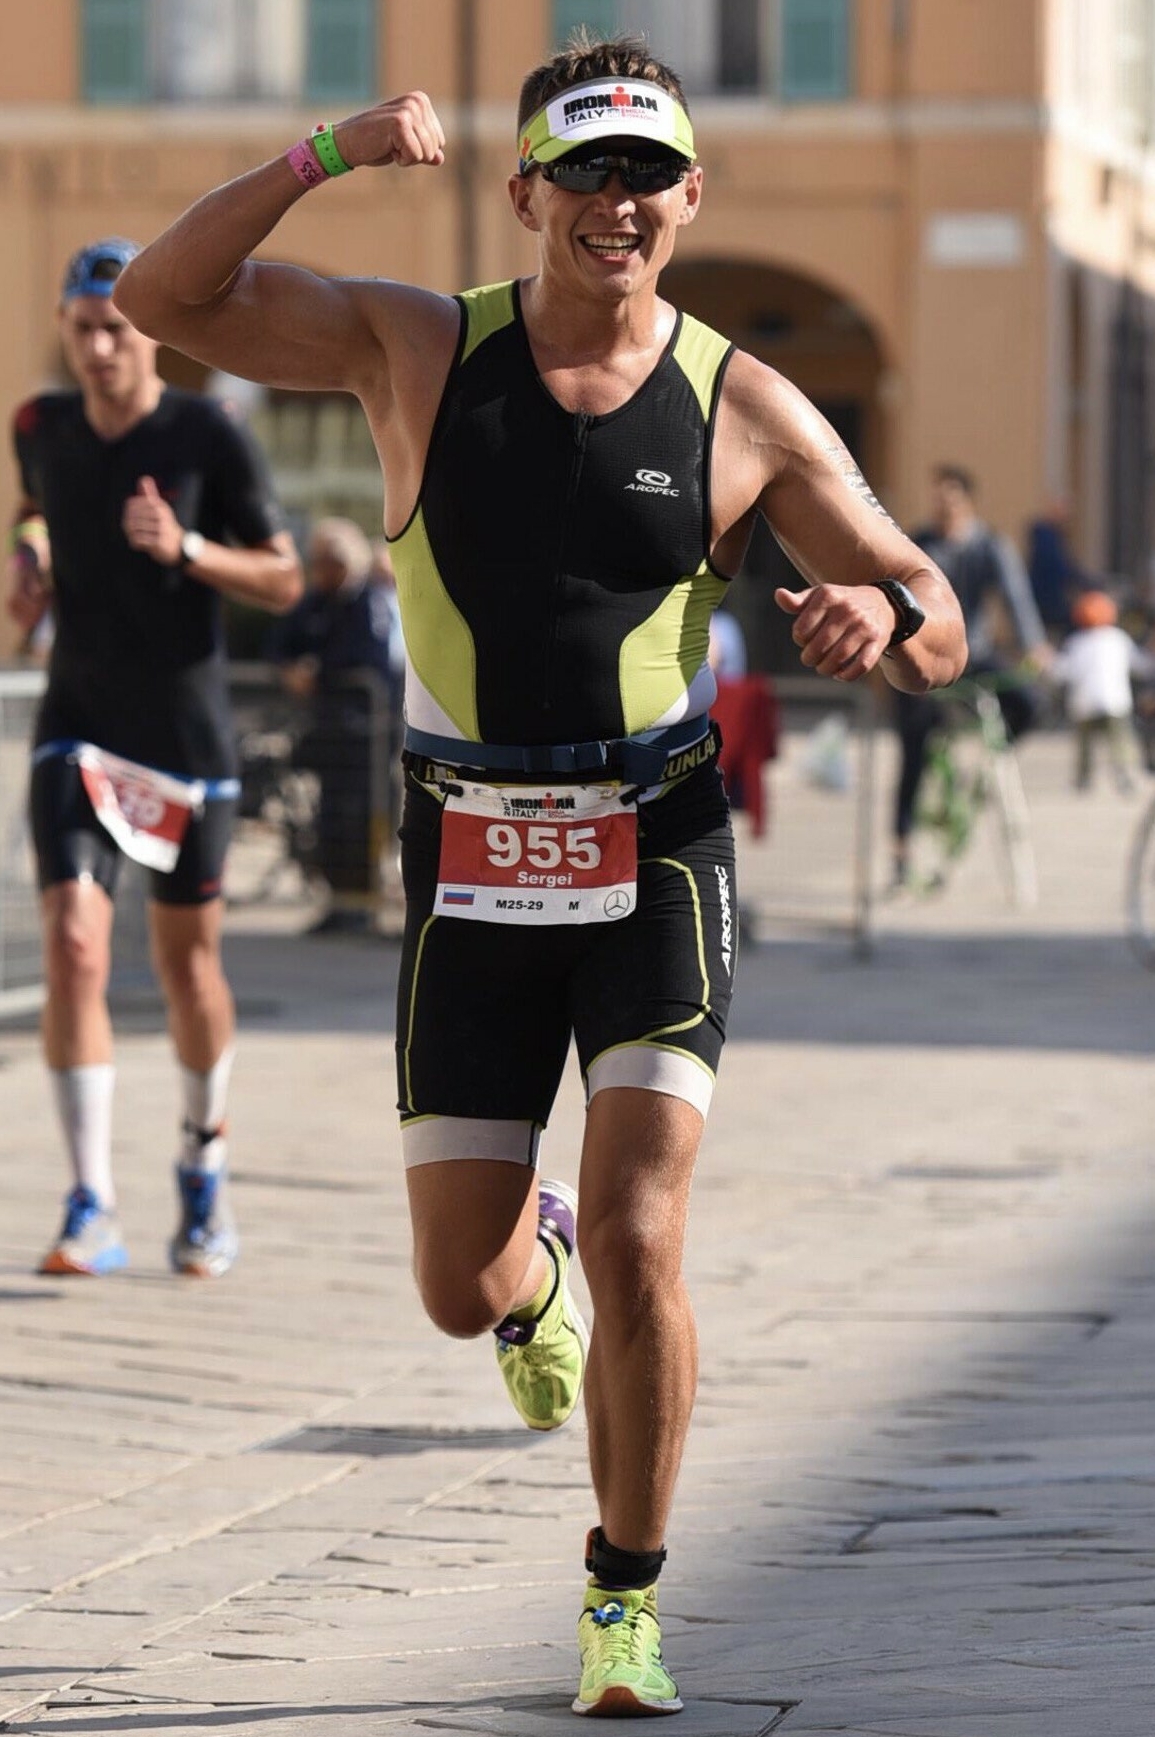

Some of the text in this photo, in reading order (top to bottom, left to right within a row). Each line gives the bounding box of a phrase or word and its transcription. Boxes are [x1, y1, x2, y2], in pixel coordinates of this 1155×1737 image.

[563, 86, 658, 116] IRONMAN
[565, 109, 605, 126] ITALY
[624, 483, 680, 497] AROPEC
[501, 797, 511, 817] 2017
[510, 792, 576, 809] IRONMAN
[512, 809, 538, 819] ITALY
[485, 824, 602, 870] 955
[517, 871, 573, 888] Sergei
[495, 899, 581, 911] M25-29 M
[714, 865, 732, 978] AROPEC
